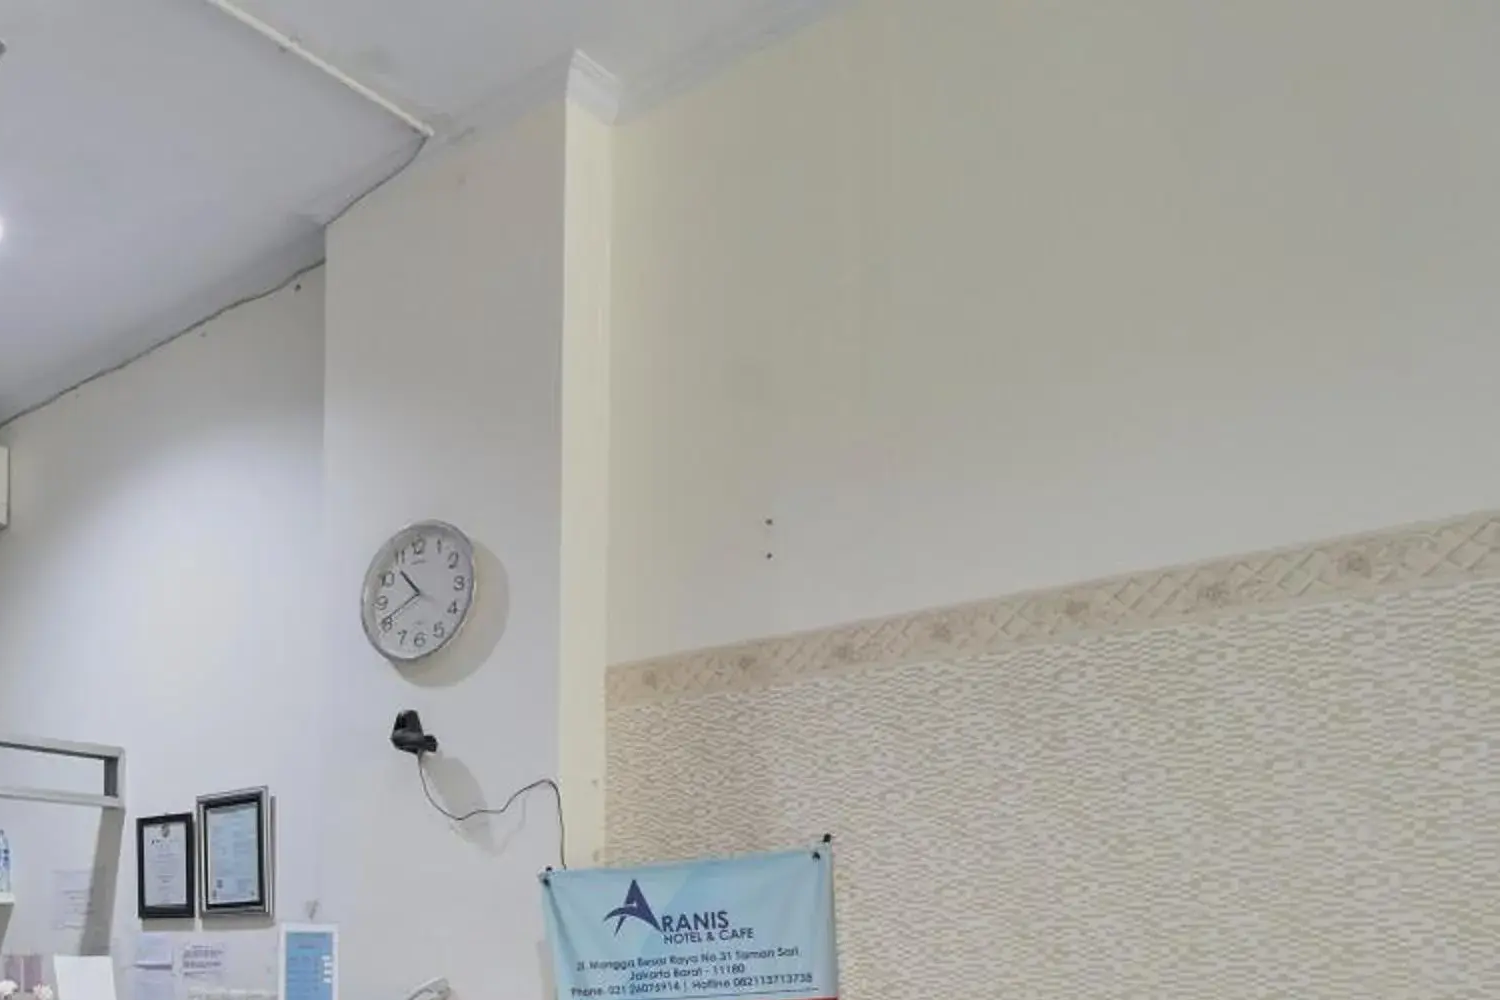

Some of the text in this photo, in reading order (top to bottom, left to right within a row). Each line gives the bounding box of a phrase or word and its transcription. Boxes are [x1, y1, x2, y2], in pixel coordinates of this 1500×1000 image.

[411, 538, 426, 555] 12
[436, 538, 442, 554] 1
[394, 549, 405, 565] 11
[447, 550, 459, 569] 2
[379, 570, 395, 588] 10
[453, 575, 465, 591] 3
[373, 594, 388, 611] 9
[447, 599, 459, 615] 4
[381, 615, 393, 633] 8
[432, 621, 445, 639] 5
[397, 629, 408, 646] 7
[413, 632, 426, 648] 6
[663, 927, 755, 945] HOTEL & CAFE
[589, 959, 635, 972] Mangga
[669, 953, 700, 967] Raya
[777, 945, 799, 957] Sari
[629, 968, 671, 981] Jakarta
[673, 965, 703, 978] Barat
[713, 962, 746, 975] 11180
